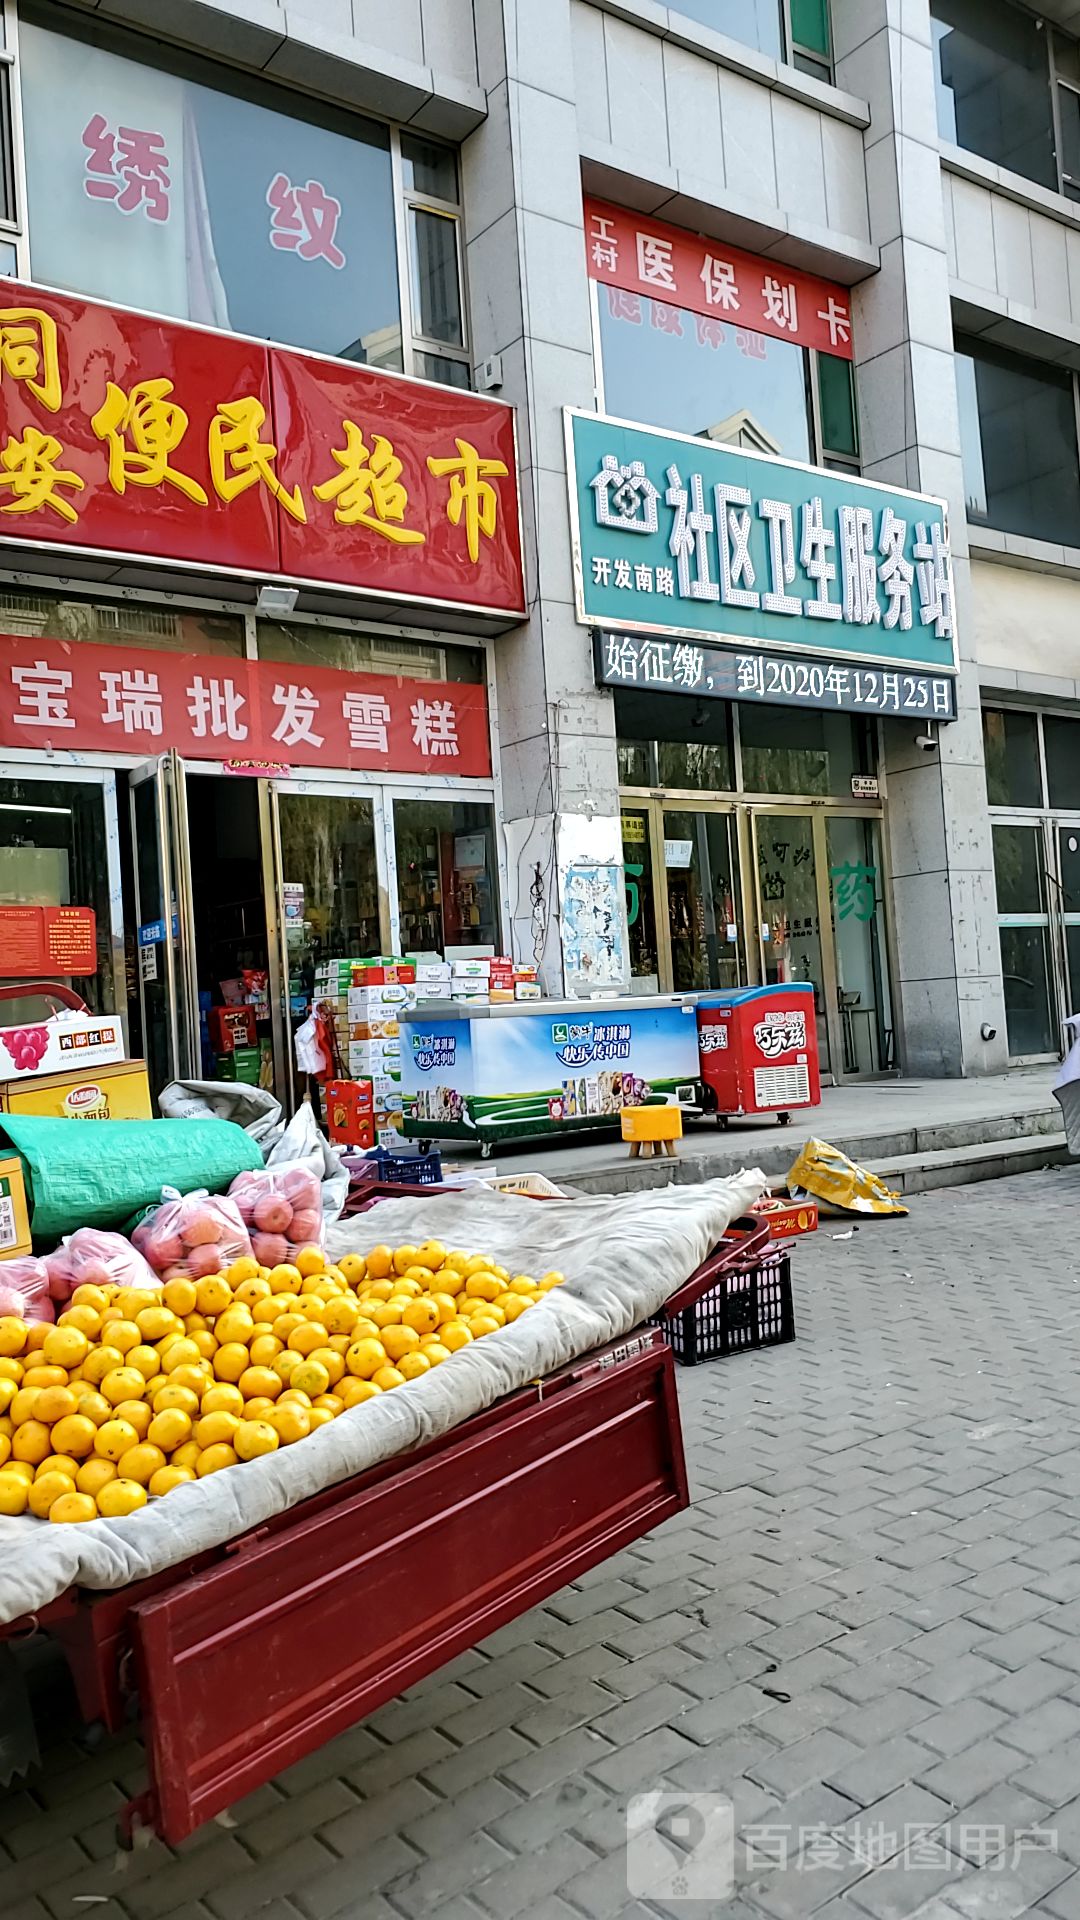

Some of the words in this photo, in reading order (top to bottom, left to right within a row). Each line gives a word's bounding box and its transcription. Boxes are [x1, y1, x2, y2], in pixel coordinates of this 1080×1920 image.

[636, 232, 851, 346] 医保划卡
[91, 377, 508, 563] 便民超市
[592, 556, 674, 596] 开发南路
[667, 463, 953, 638] 社区卫生服务站
[11, 660, 460, 756] 宝瑞批发雪糕
[830, 860, 876, 922] 药
[59, 1028, 115, 1050] 西部红提
[563, 1041, 630, 1062] 快乐传中国
[594, 1025, 631, 1042] 冰淇淋
